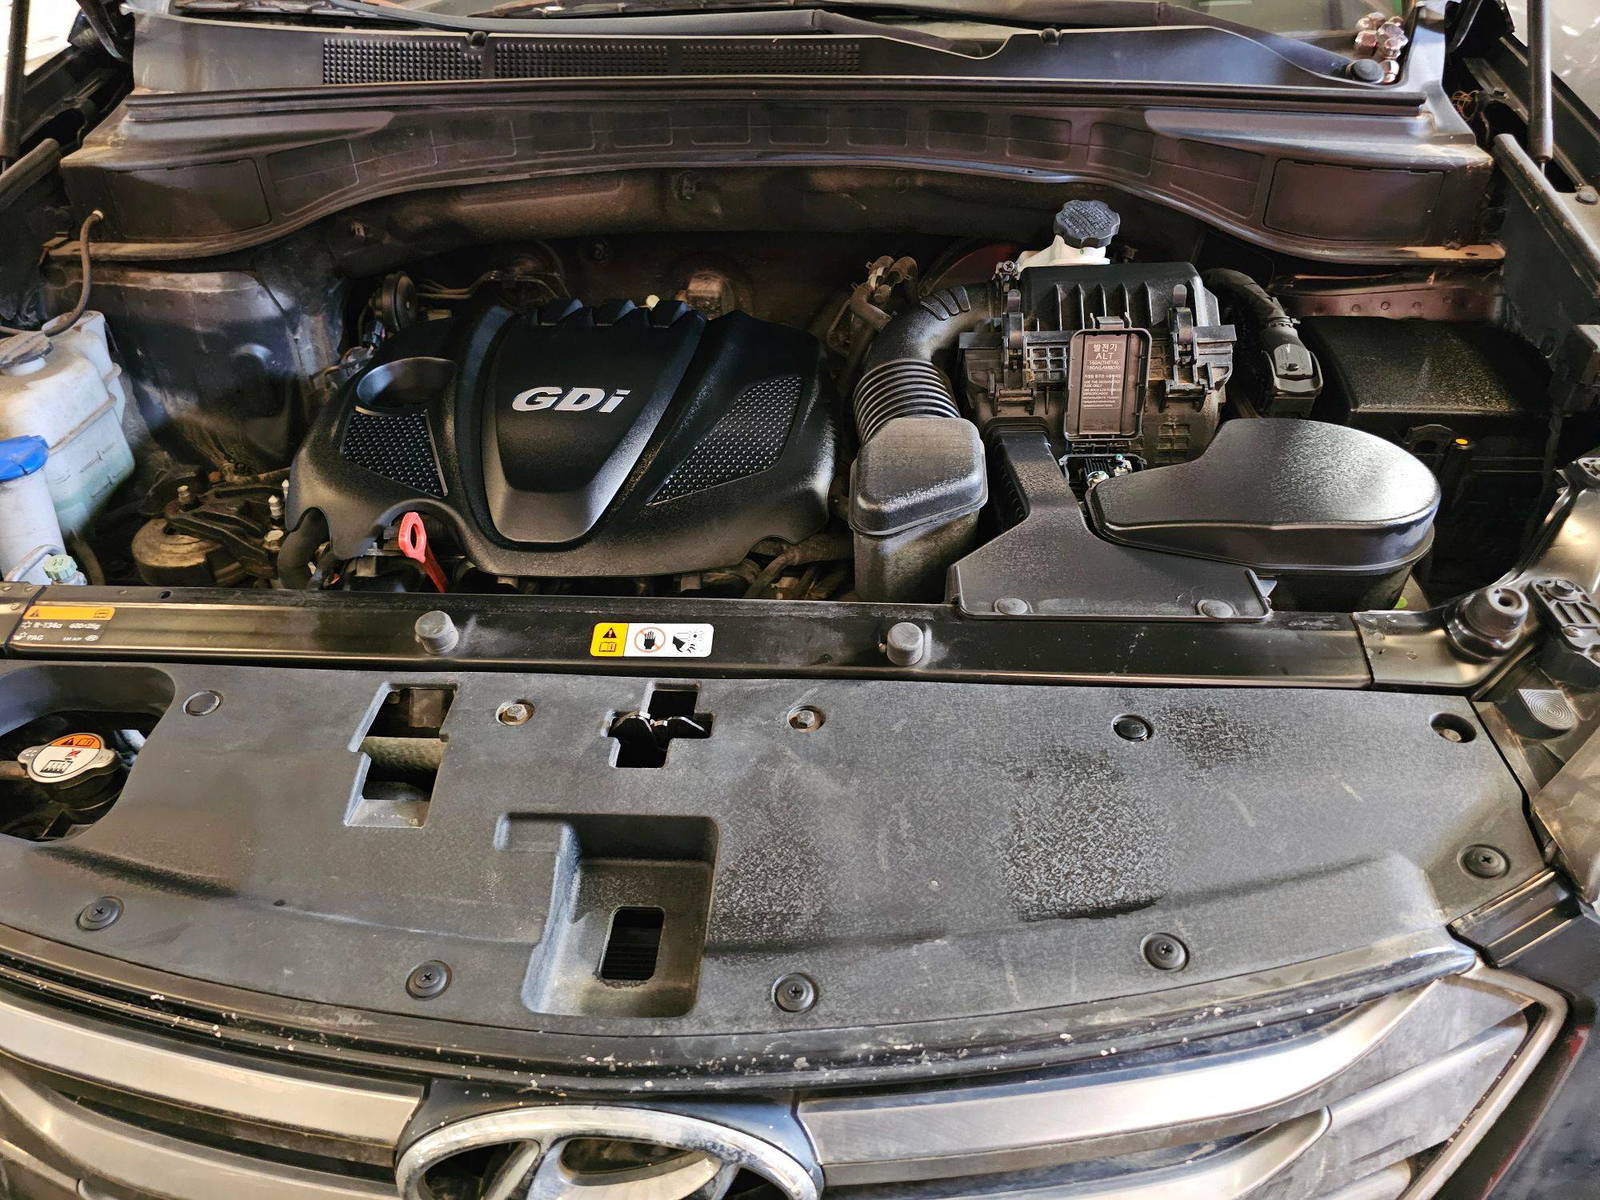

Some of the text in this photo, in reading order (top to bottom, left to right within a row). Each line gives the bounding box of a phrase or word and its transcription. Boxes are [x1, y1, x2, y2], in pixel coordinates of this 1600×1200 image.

[1093, 343, 1118, 353] 발전기
[1095, 352, 1115, 360] ALT
[511, 386, 632, 413] GDi
